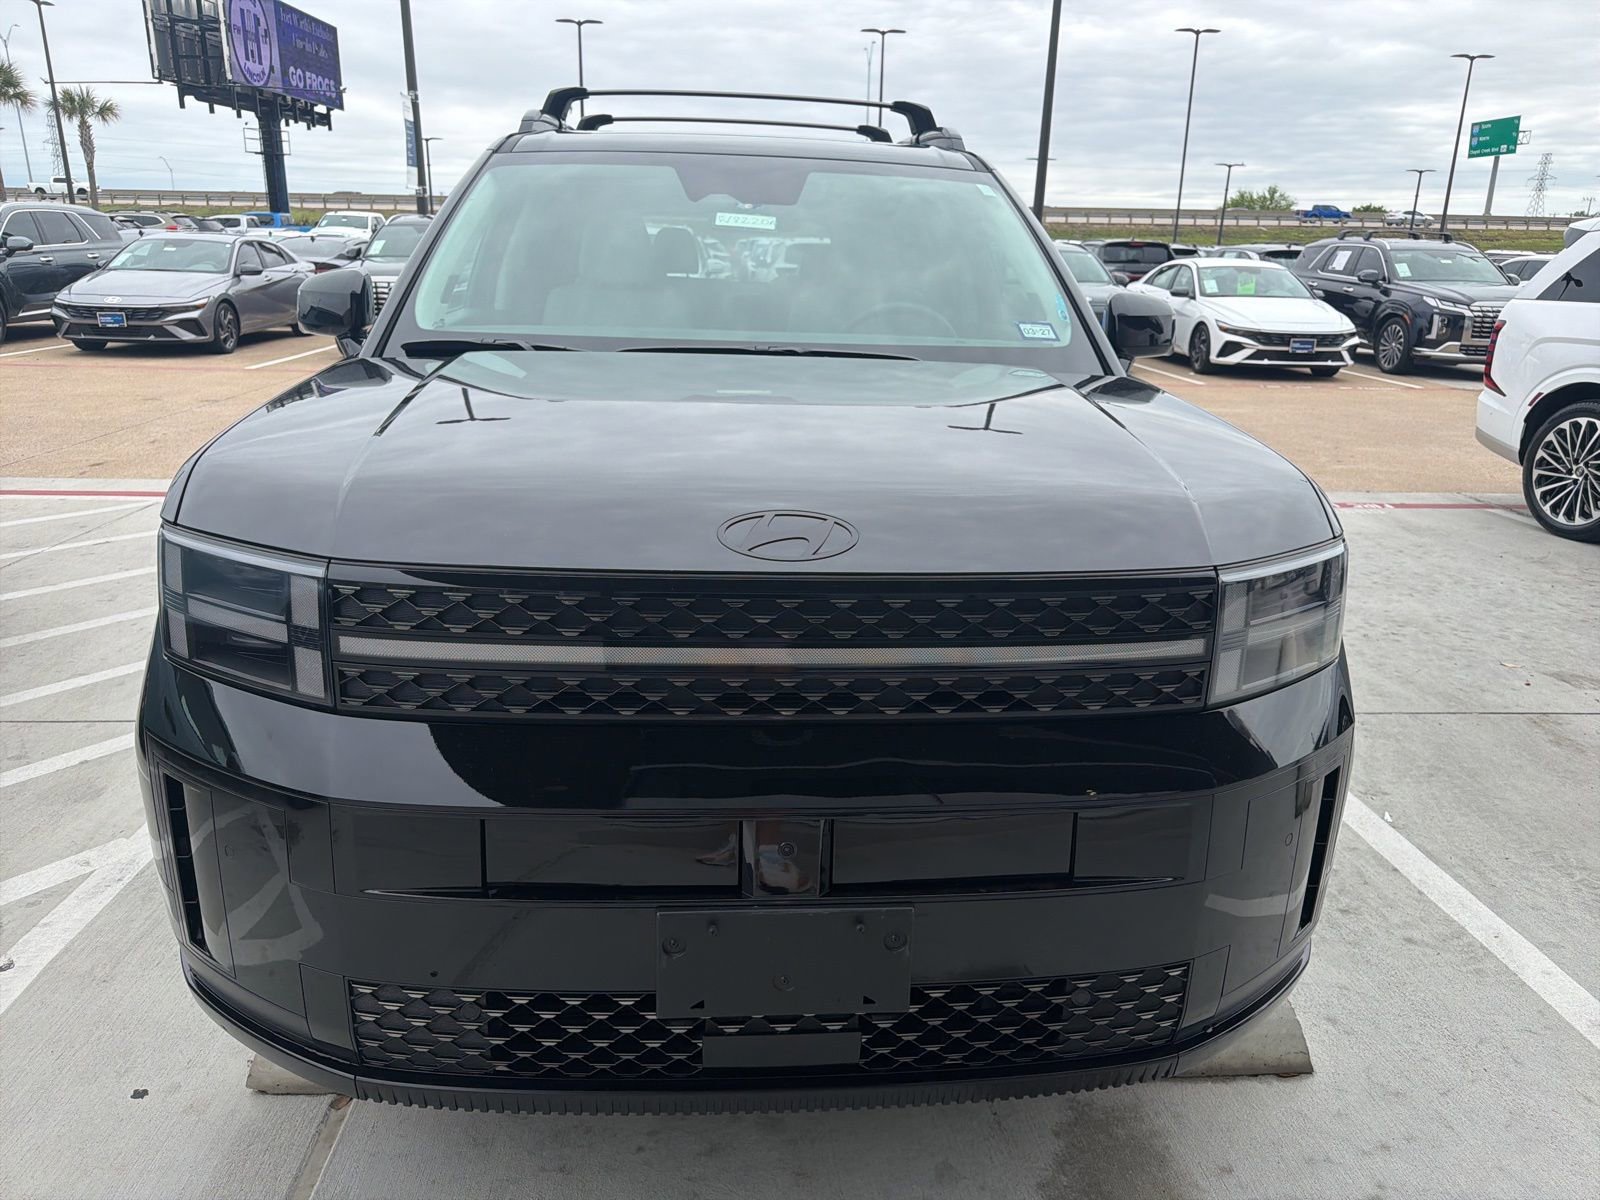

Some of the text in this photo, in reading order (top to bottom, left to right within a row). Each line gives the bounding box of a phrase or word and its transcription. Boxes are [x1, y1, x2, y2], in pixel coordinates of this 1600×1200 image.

[244, 62, 266, 83] LINCOLN
[288, 66, 336, 98] GO FROGS
